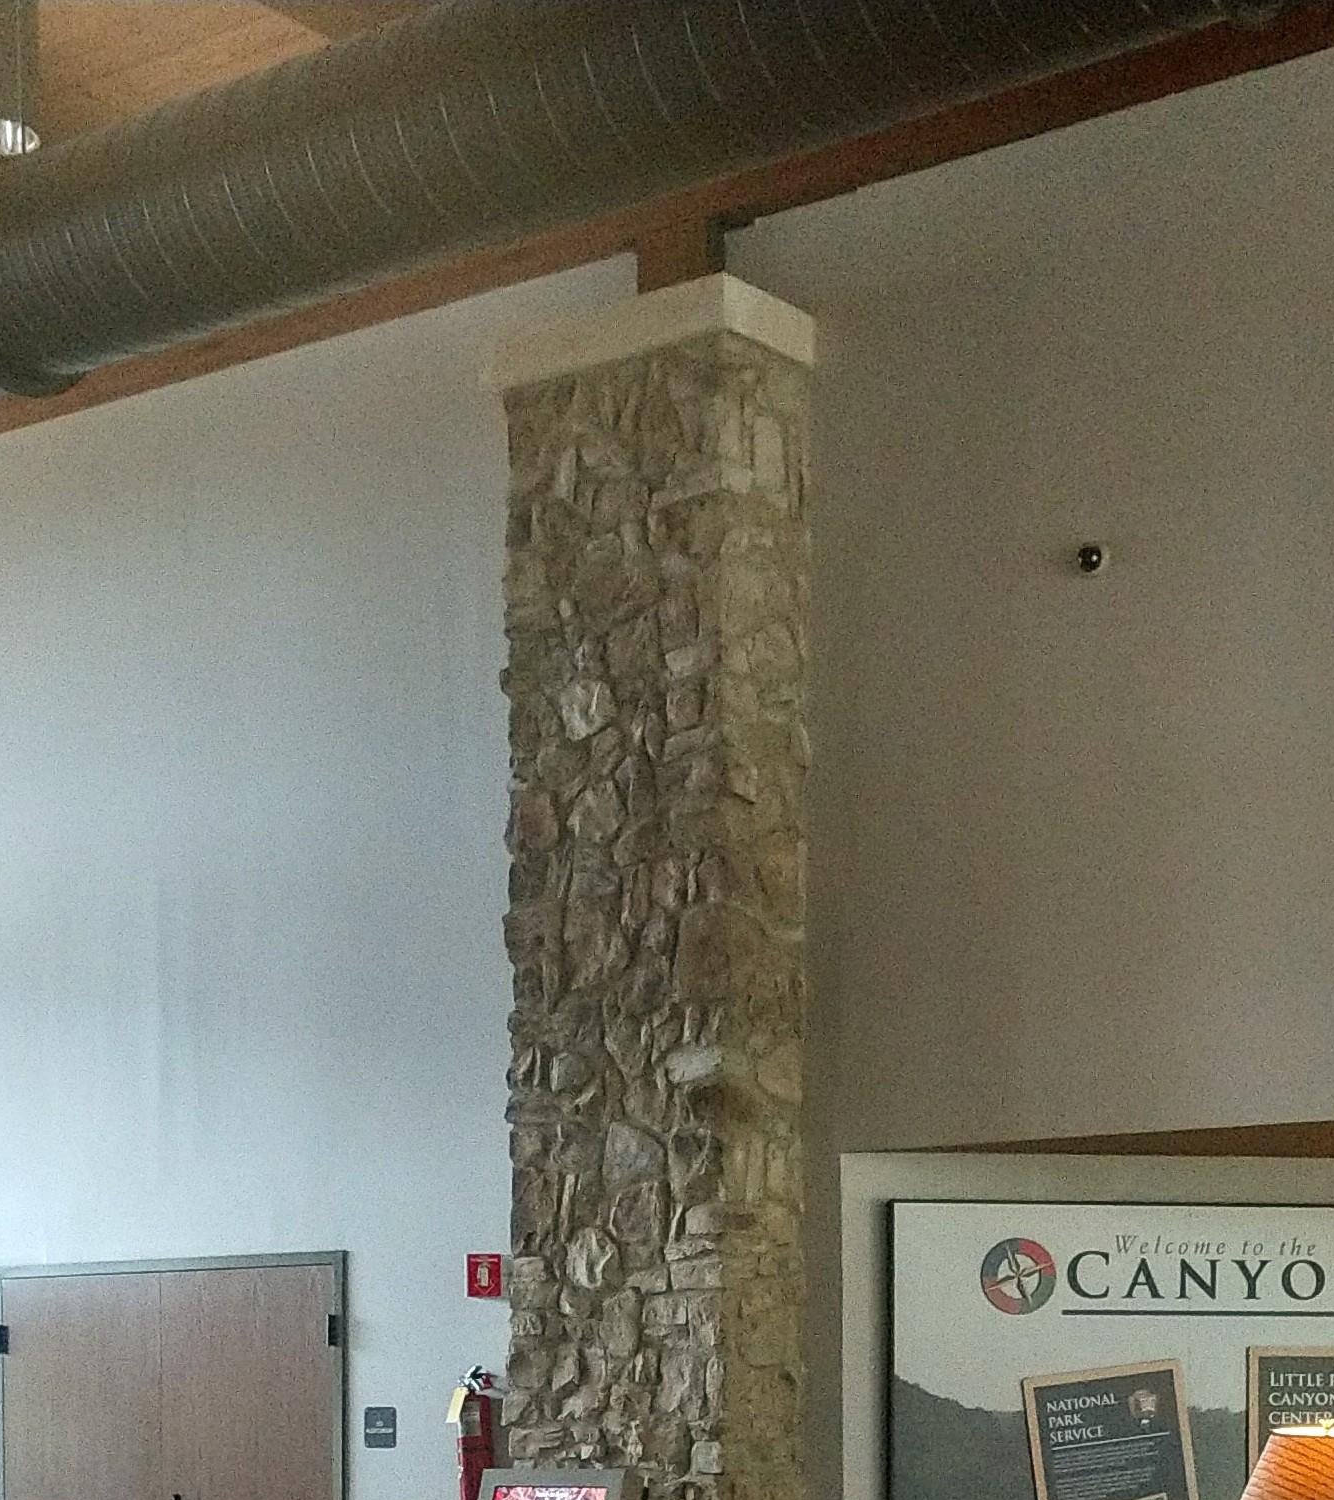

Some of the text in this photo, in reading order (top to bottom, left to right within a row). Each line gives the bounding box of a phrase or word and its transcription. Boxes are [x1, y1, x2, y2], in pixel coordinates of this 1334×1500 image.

[1115, 1234, 1317, 1257] Welcome to the
[1270, 1371, 1324, 1388] LITTLE
[1046, 1393, 1118, 1414] NATIONAL
[1048, 1414, 1084, 1429] PARK
[1049, 1425, 1105, 1444] SERVICE
